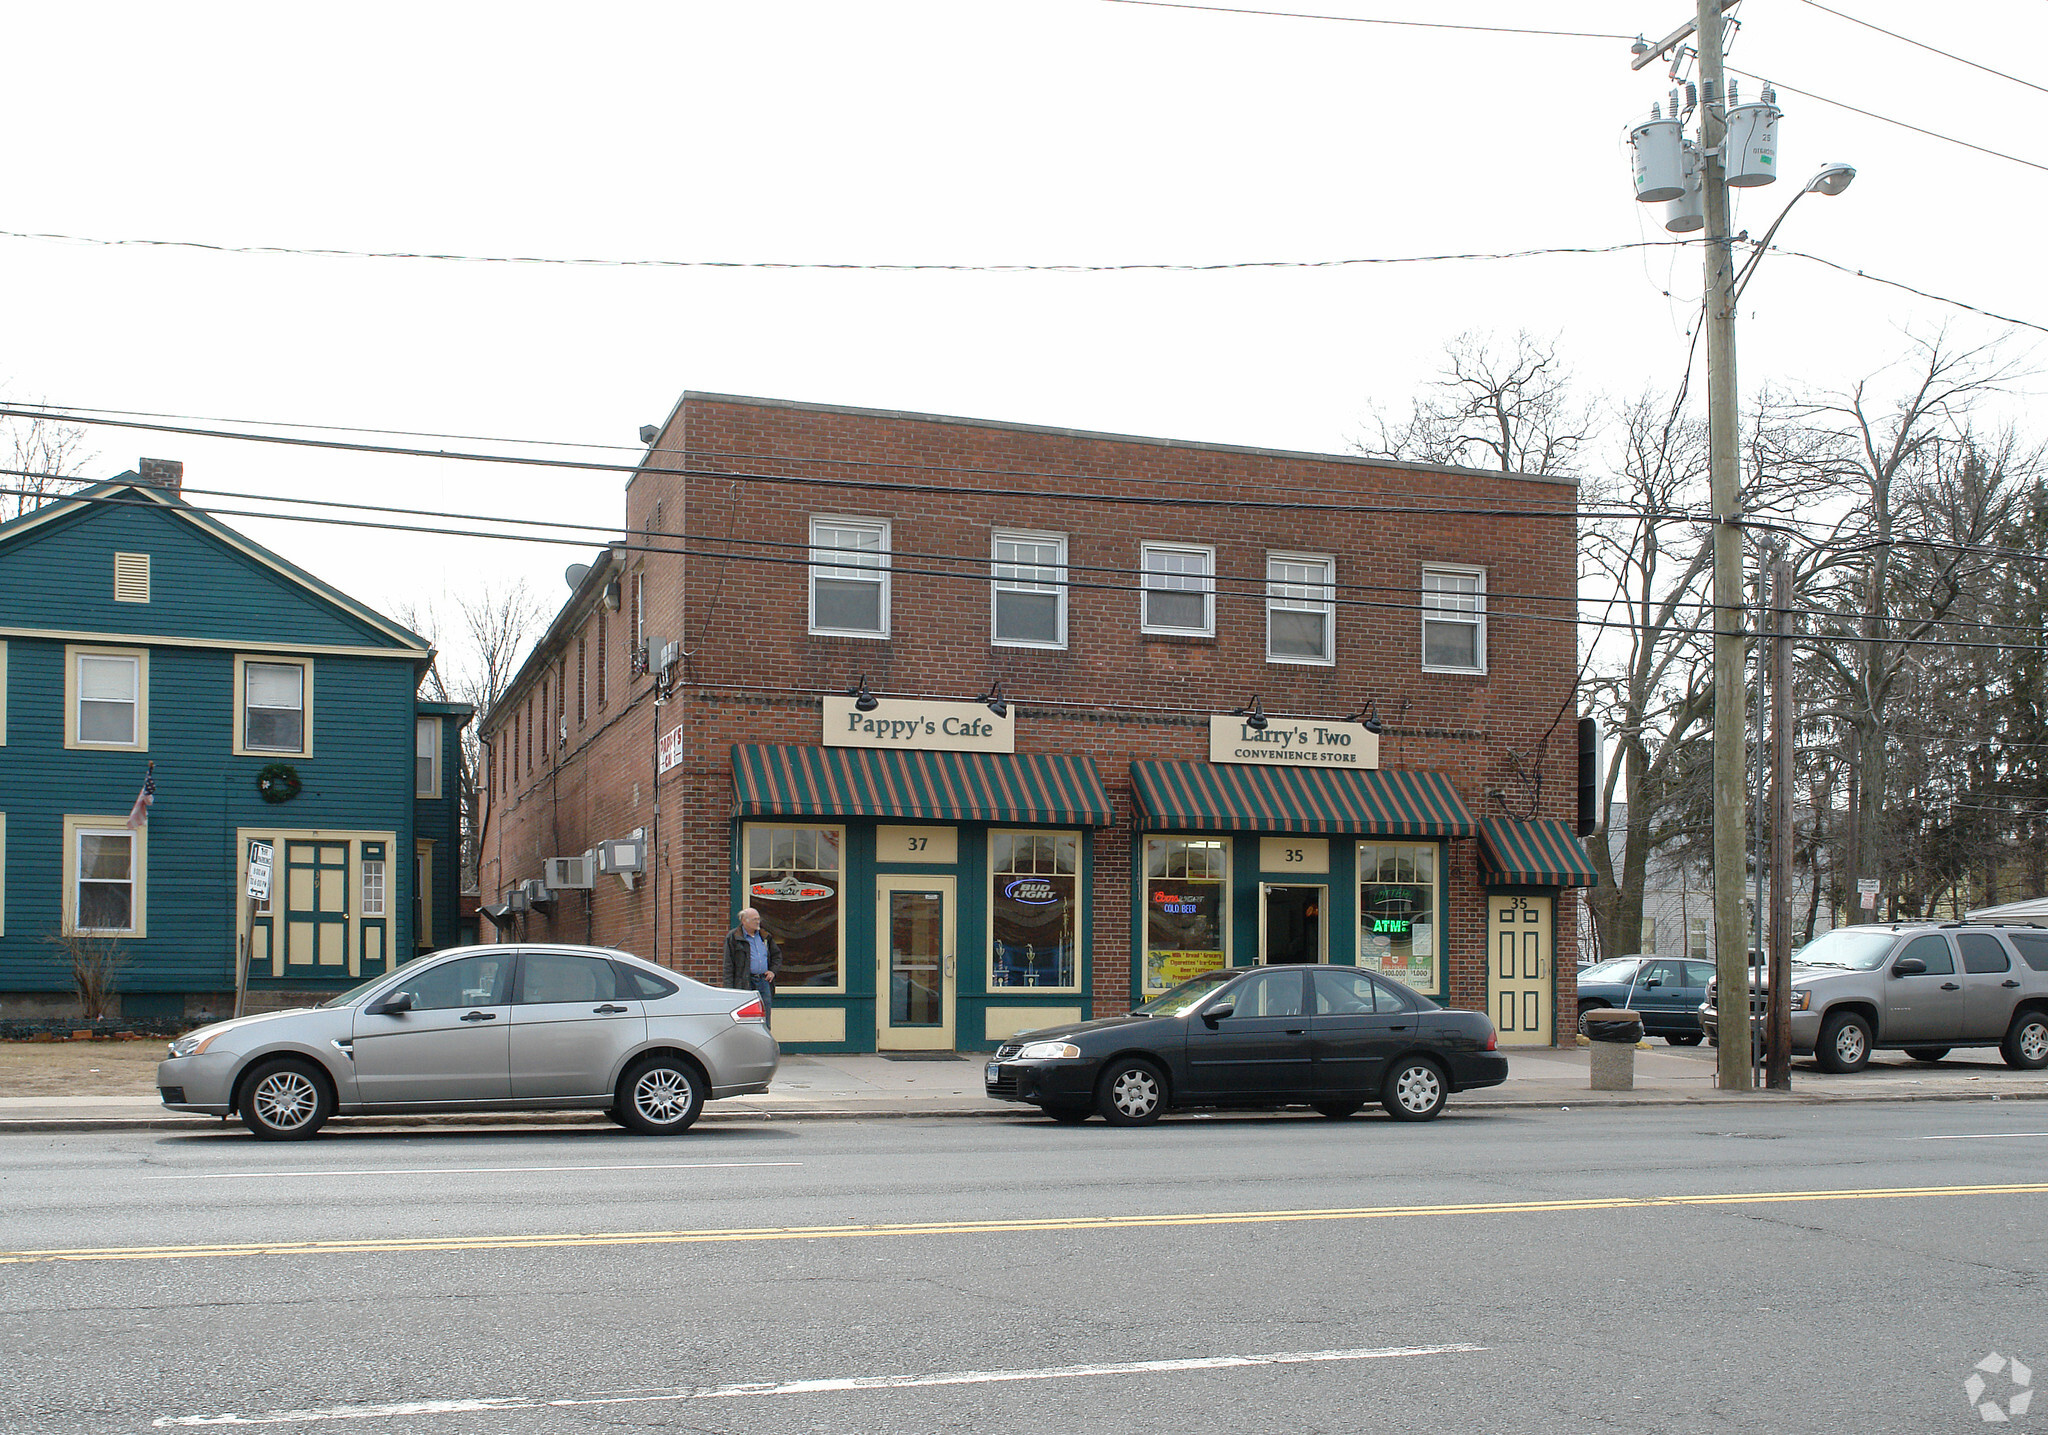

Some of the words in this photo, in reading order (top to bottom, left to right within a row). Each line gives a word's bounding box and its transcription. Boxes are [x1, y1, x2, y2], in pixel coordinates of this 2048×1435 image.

[1762, 134, 1771, 142] 25
[848, 713, 936, 740] Pappy's
[942, 717, 993, 737] Cafe
[1241, 724, 1309, 749] Larry's
[1314, 728, 1351, 746] Two
[1234, 749, 1318, 761] CONVENIENCE
[1320, 752, 1357, 763] STORE
[908, 837, 928, 851] 37
[1285, 849, 1304, 862] 35
[800, 889, 826, 897] ESPN
[1013, 891, 1056, 899] LIGHT
[1154, 891, 1180, 903] Coors
[1164, 904, 1180, 913] COLD
[1181, 904, 1197, 914] BEER
[1510, 897, 1528, 910] 35
[1373, 919, 1401, 932] ATM
[1203, 952, 1222, 960] Grocery
